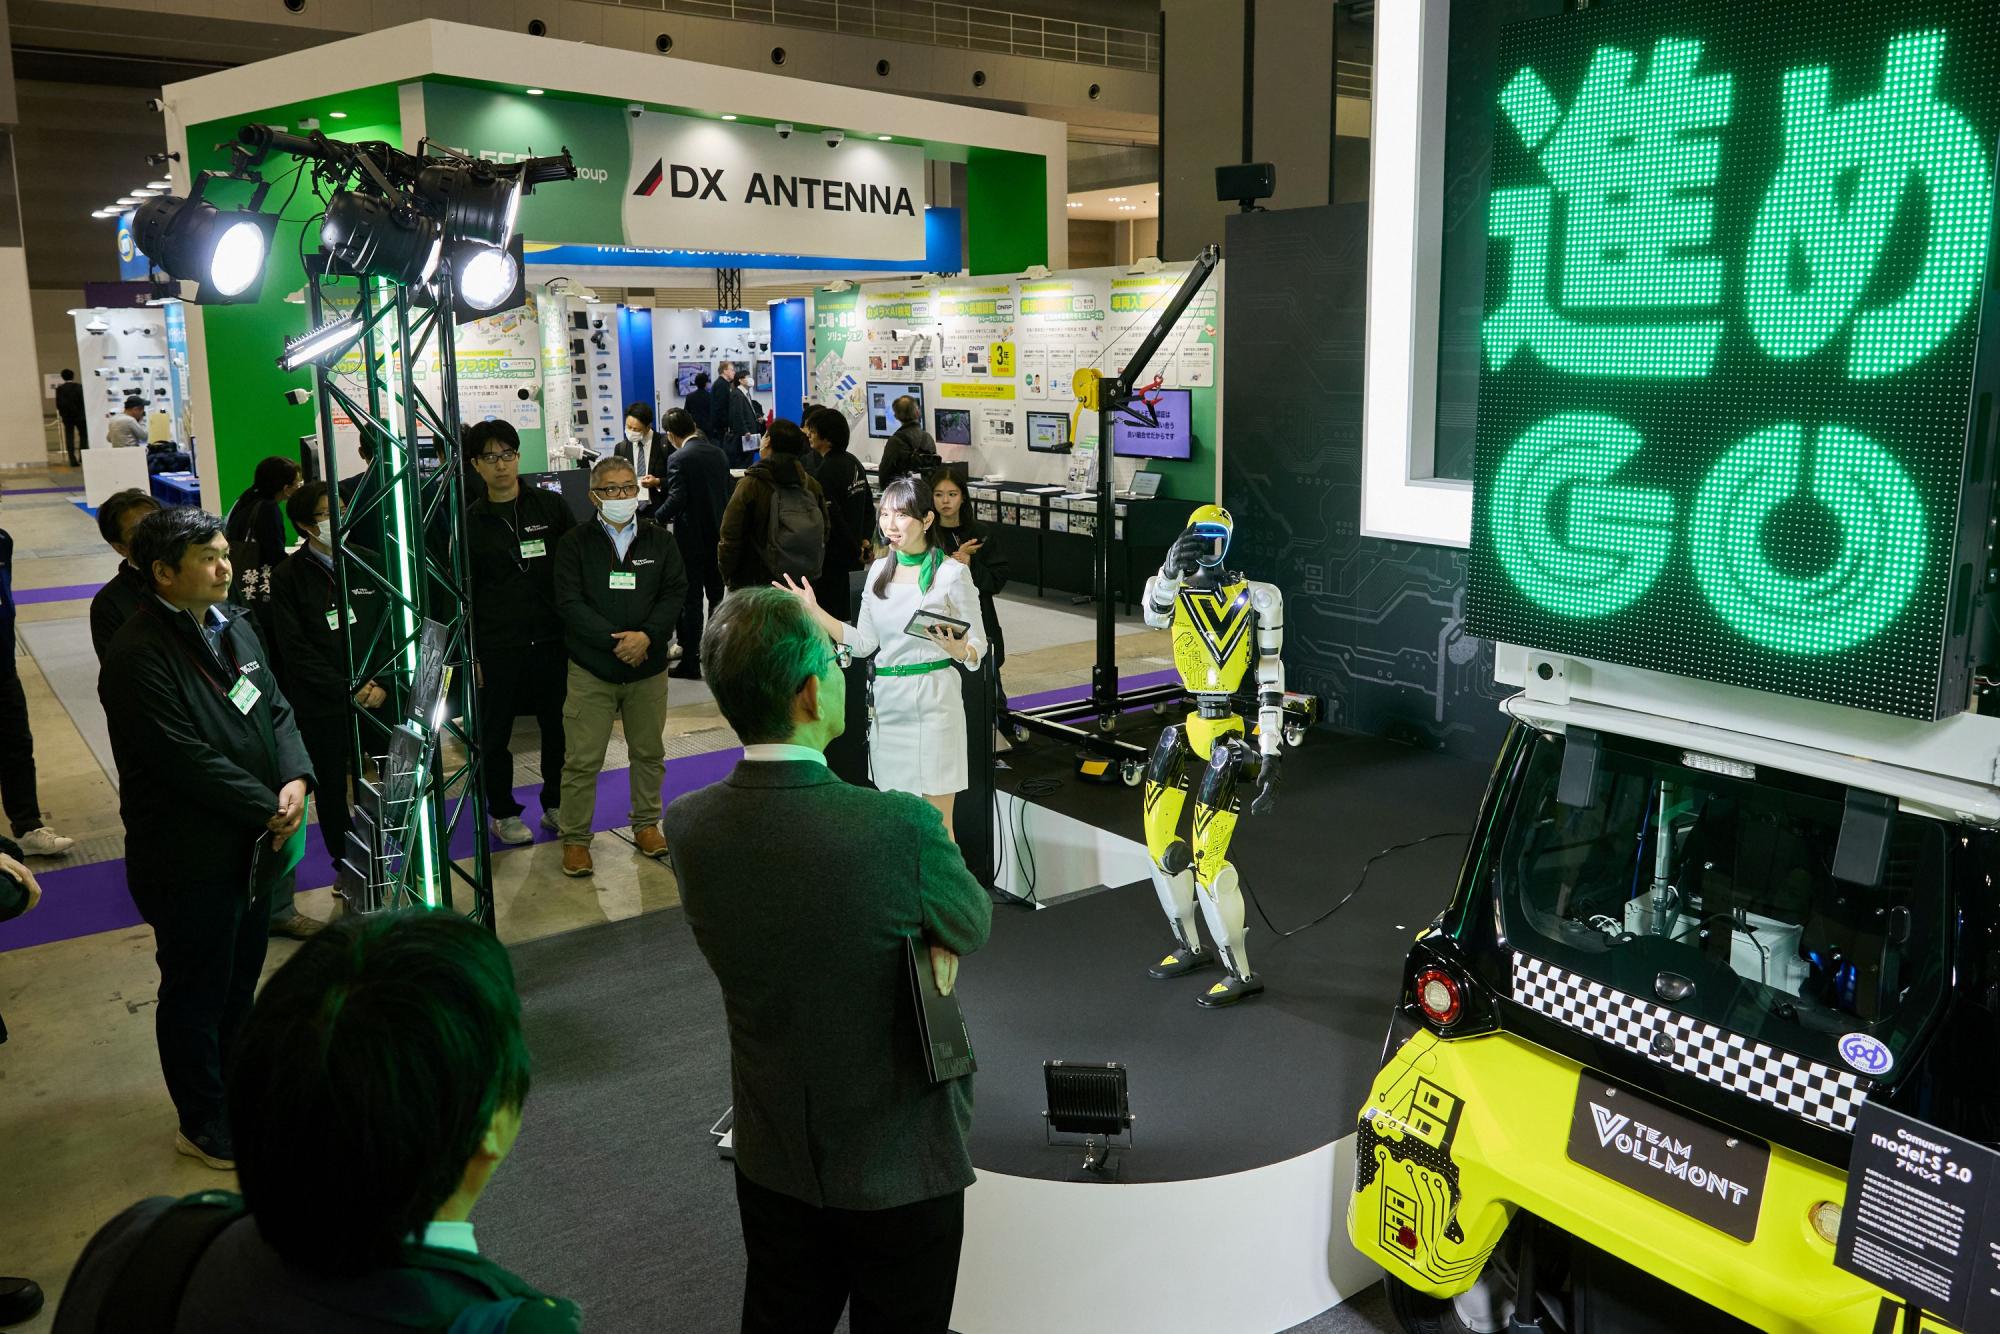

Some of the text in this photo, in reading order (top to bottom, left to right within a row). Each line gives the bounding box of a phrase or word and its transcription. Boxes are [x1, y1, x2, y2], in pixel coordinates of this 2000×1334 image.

[576, 167, 609, 184] roup
[671, 163, 916, 217] DX ANTENNA
[1482, 28, 1992, 379] 進め
[1489, 409, 1929, 656] GO
[1589, 1101, 1749, 1206] VOLLMONT
[1633, 1121, 1692, 1160] TEAM
[1871, 1133, 1973, 1184] model-S 2.0
[1896, 1157, 1942, 1185] アドバンス
